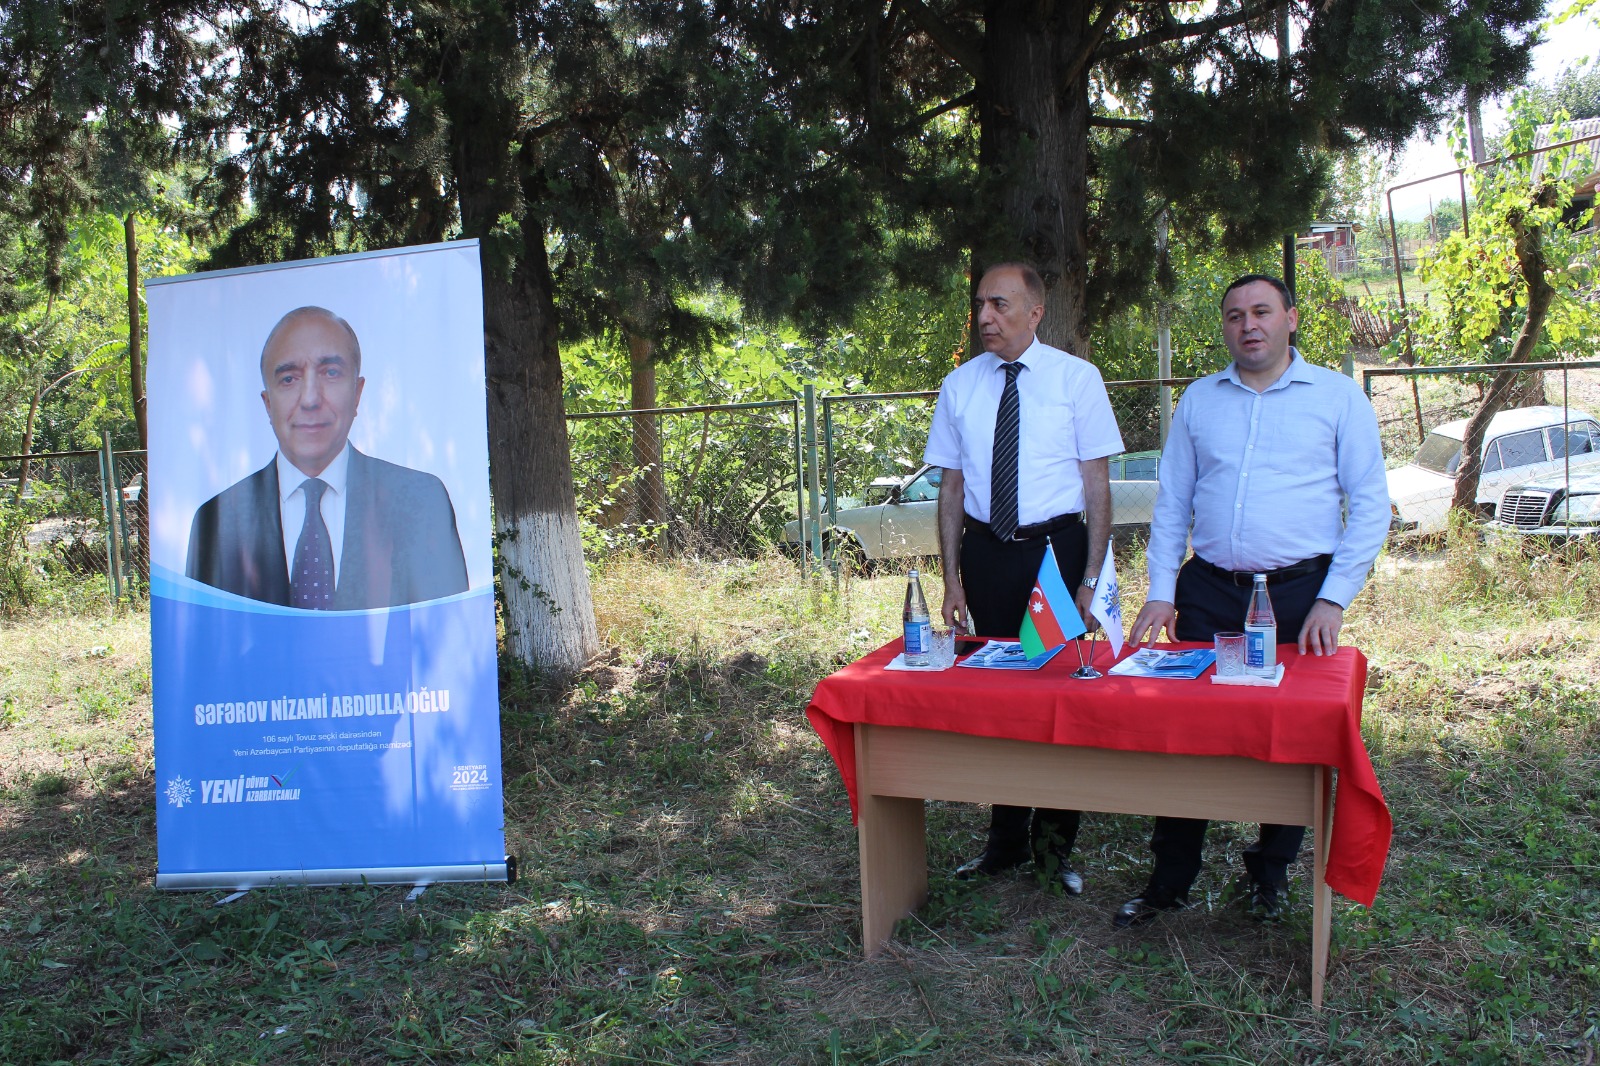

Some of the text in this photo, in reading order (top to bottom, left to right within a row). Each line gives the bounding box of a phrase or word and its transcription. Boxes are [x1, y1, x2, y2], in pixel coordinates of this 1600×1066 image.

[271, 693, 328, 721] NİZAMİ
[331, 692, 404, 718] ABDULLA
[407, 686, 450, 714] OĞLU
[277, 734, 294, 744] saylı
[296, 733, 317, 741] Tovuz
[318, 731, 338, 741] seçki
[339, 730, 382, 739] dairəsindən
[233, 740, 412, 757] Yeni Azərbaycan Partiyasının deputatlığa namizədi
[453, 769, 489, 785] 2024
[201, 774, 245, 804] YENİ
